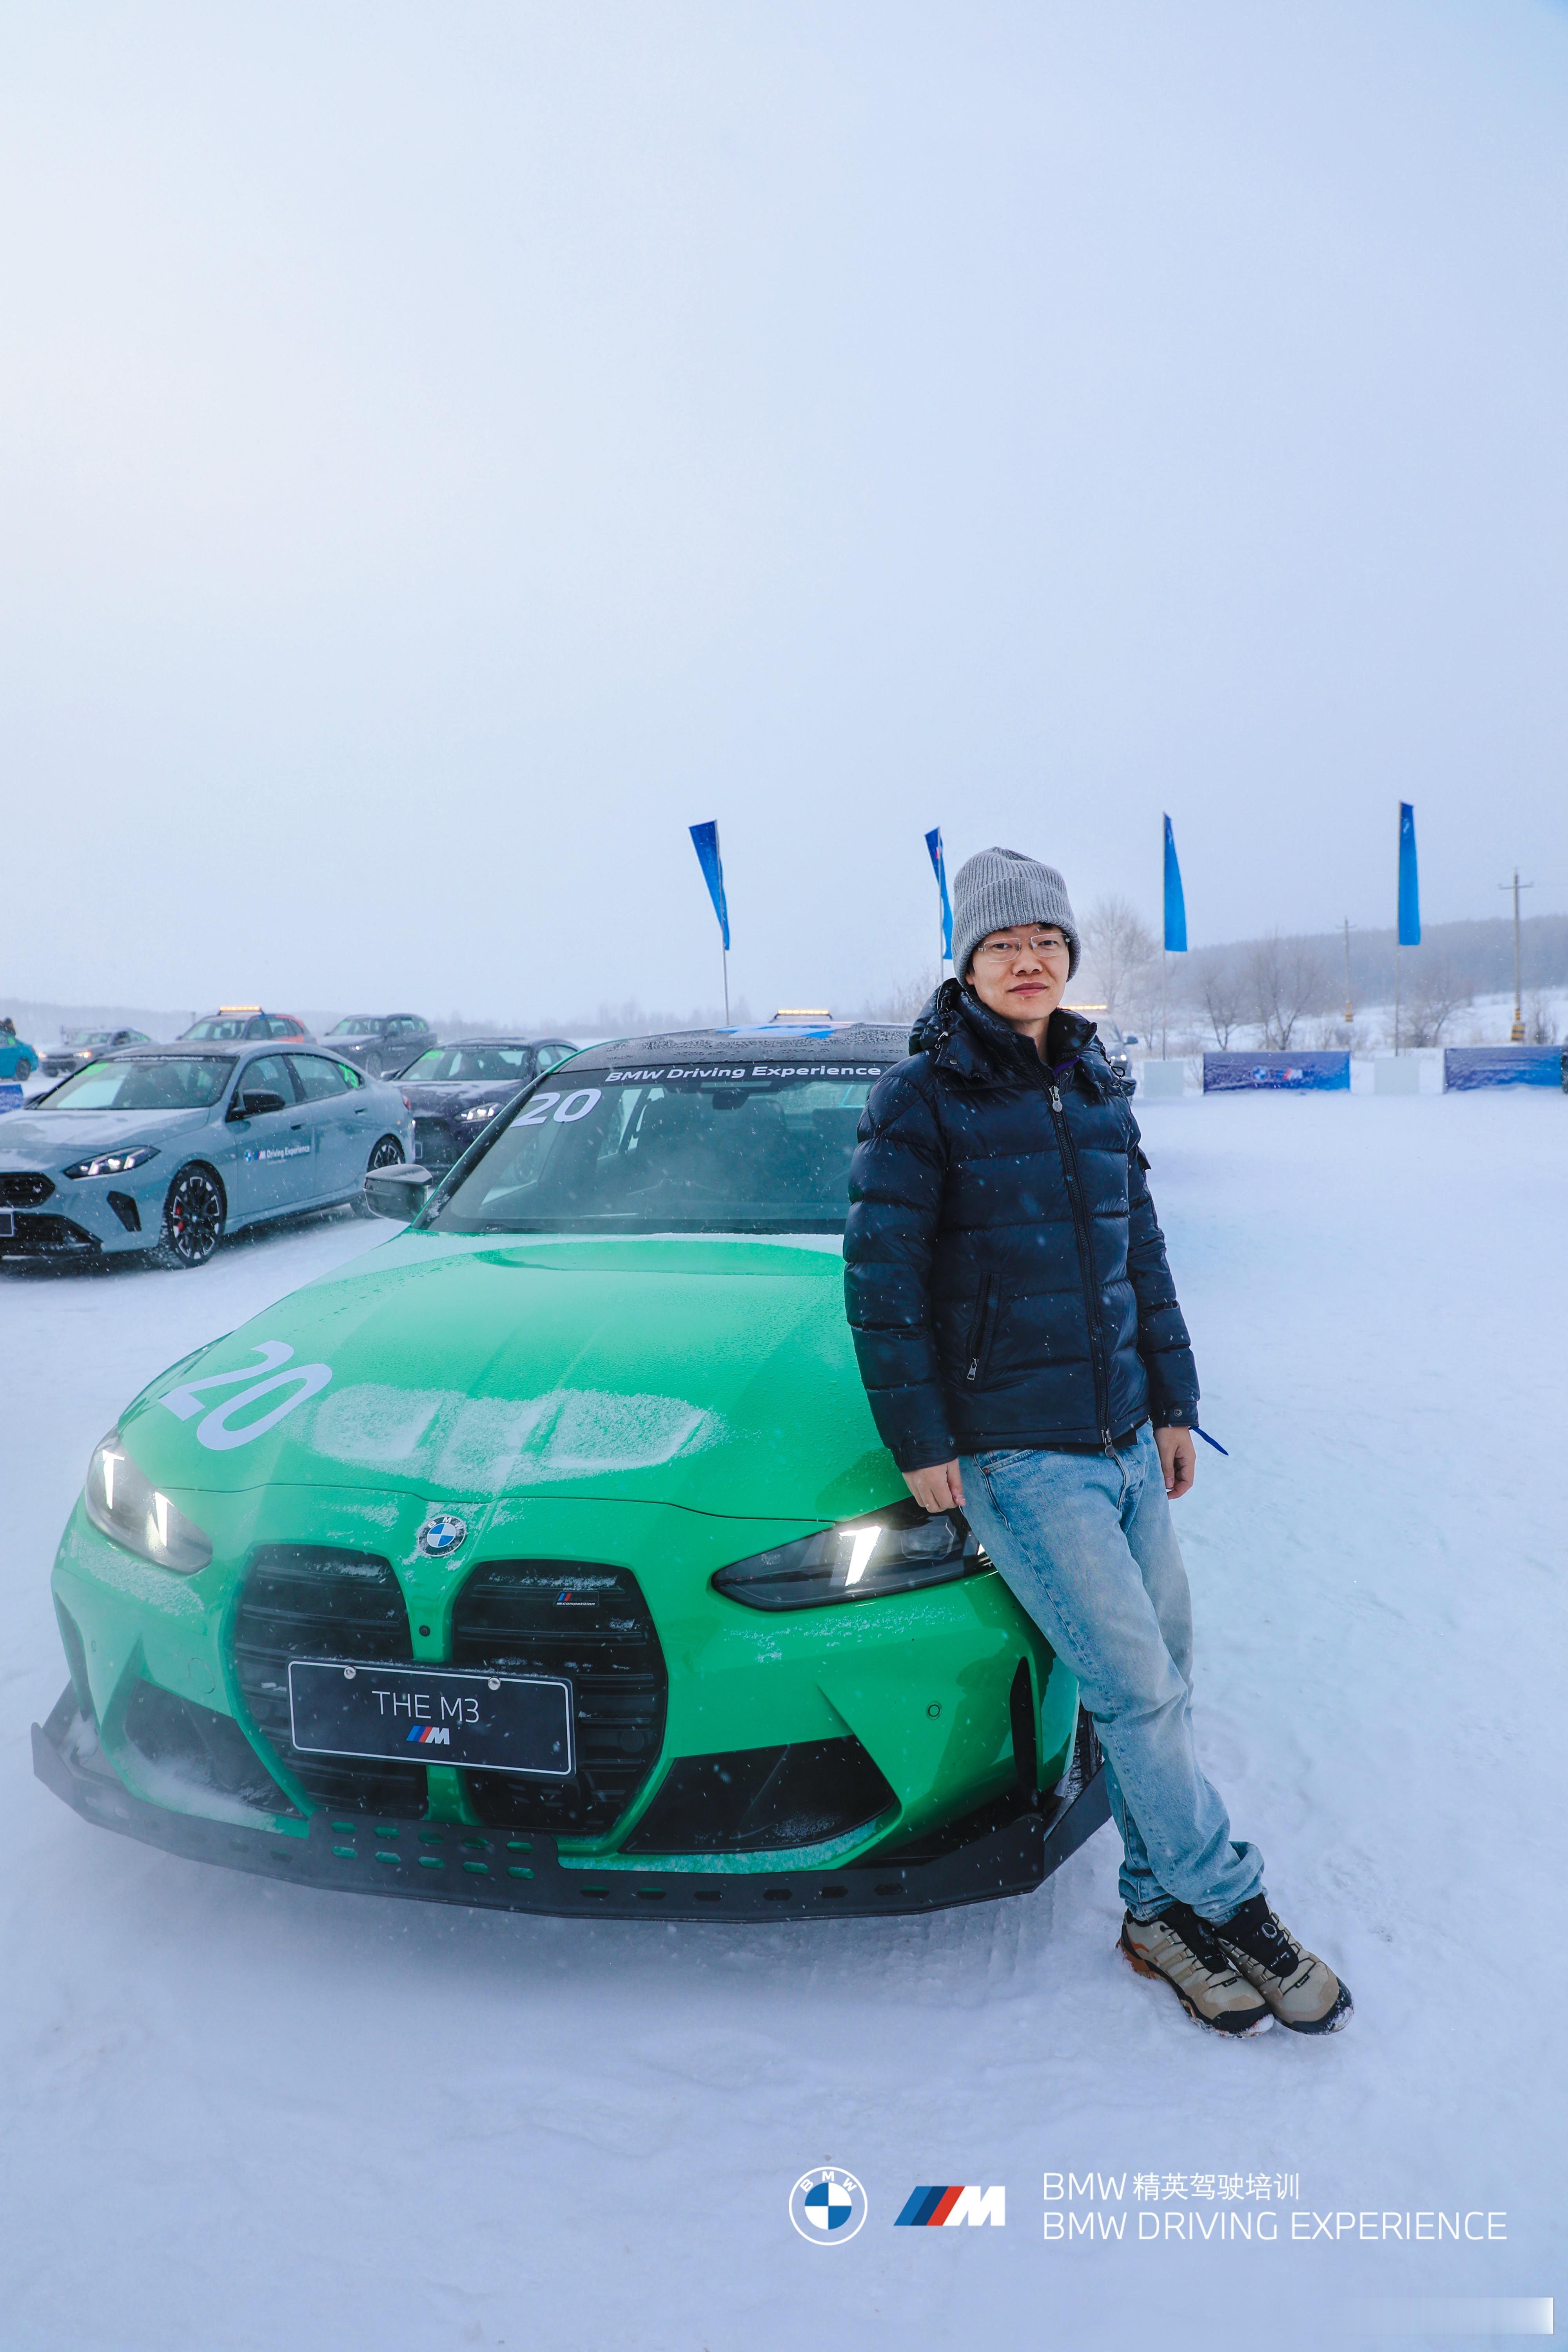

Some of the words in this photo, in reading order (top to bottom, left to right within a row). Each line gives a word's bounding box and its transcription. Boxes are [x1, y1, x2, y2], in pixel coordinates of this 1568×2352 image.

[605, 1070, 665, 1082] BMW
[666, 1067, 746, 1078] Driving
[751, 1065, 881, 1077] Experience
[510, 1088, 601, 1128] 20
[267, 1149, 284, 1159] Driving
[285, 1145, 310, 1156] Experience
[158, 1340, 332, 1450] 20
[428, 1517, 464, 1530] BMW
[372, 1690, 431, 1719] THE
[441, 1696, 479, 1723] M3
